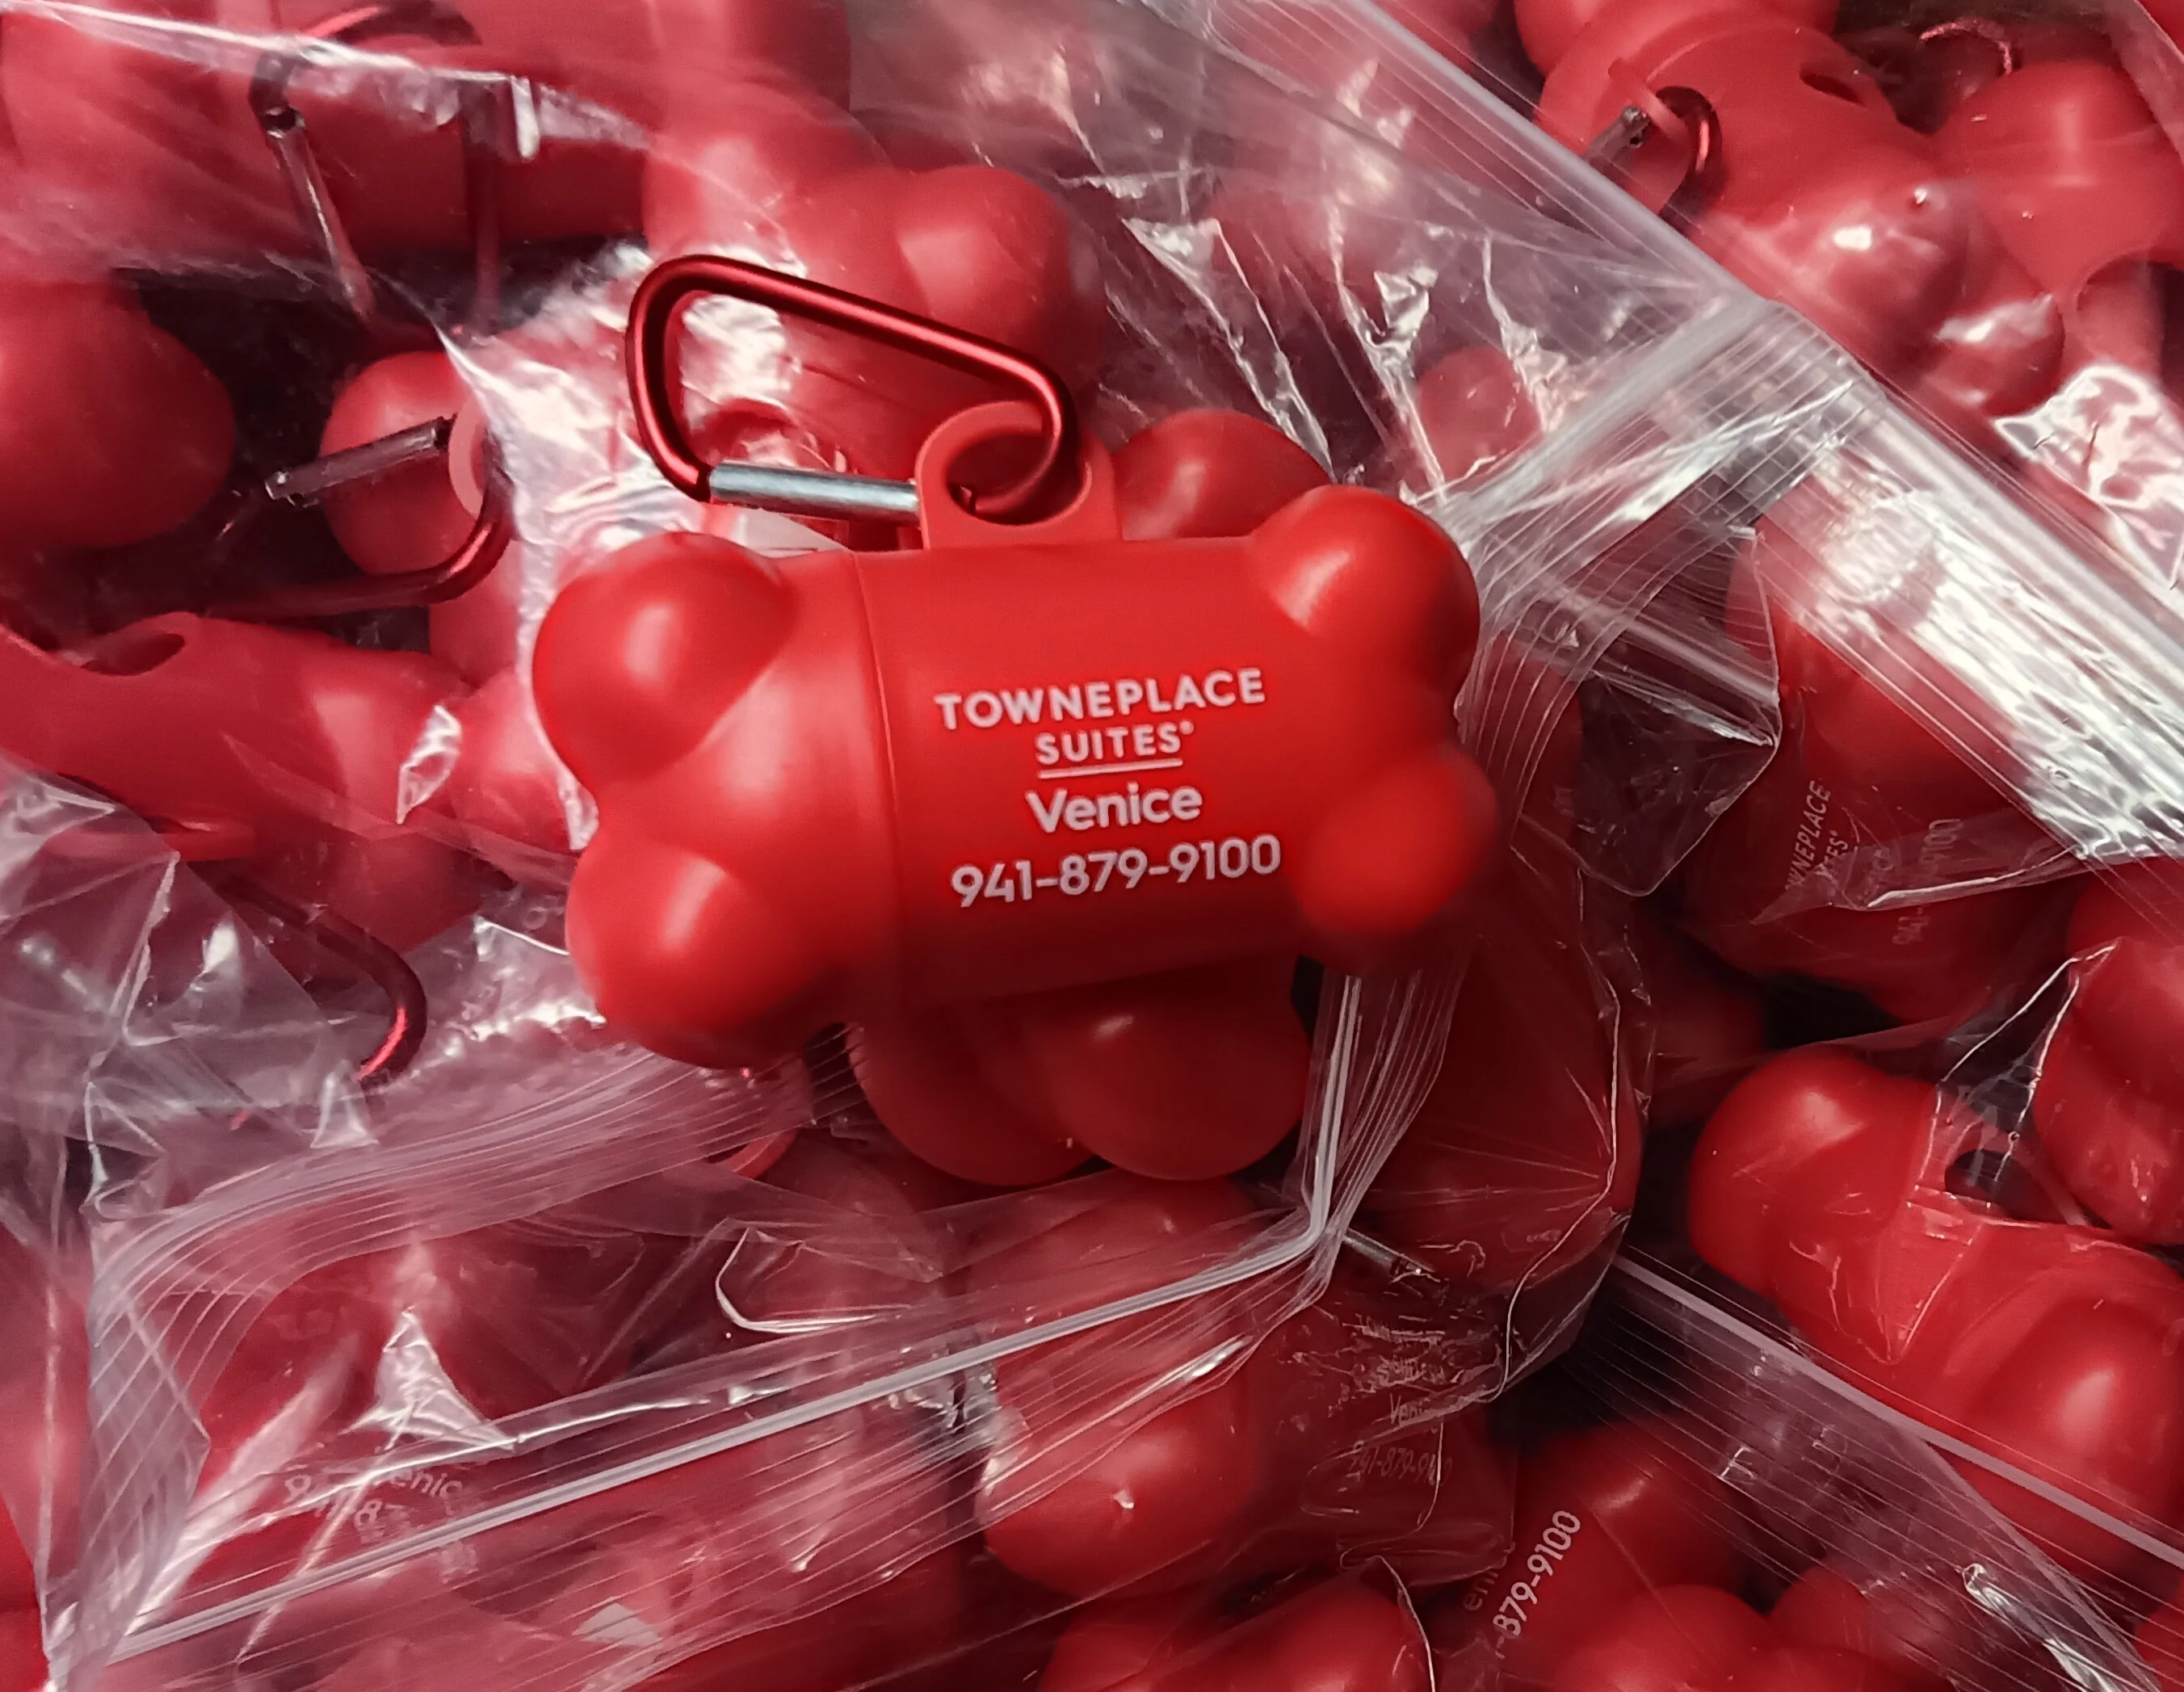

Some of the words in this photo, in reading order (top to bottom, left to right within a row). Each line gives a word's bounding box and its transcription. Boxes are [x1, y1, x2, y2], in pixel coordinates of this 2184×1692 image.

[934, 668, 1266, 730] TOWNEPLACE
[1025, 781, 1203, 833] Venice
[951, 833, 1281, 908] 941-879-9100
